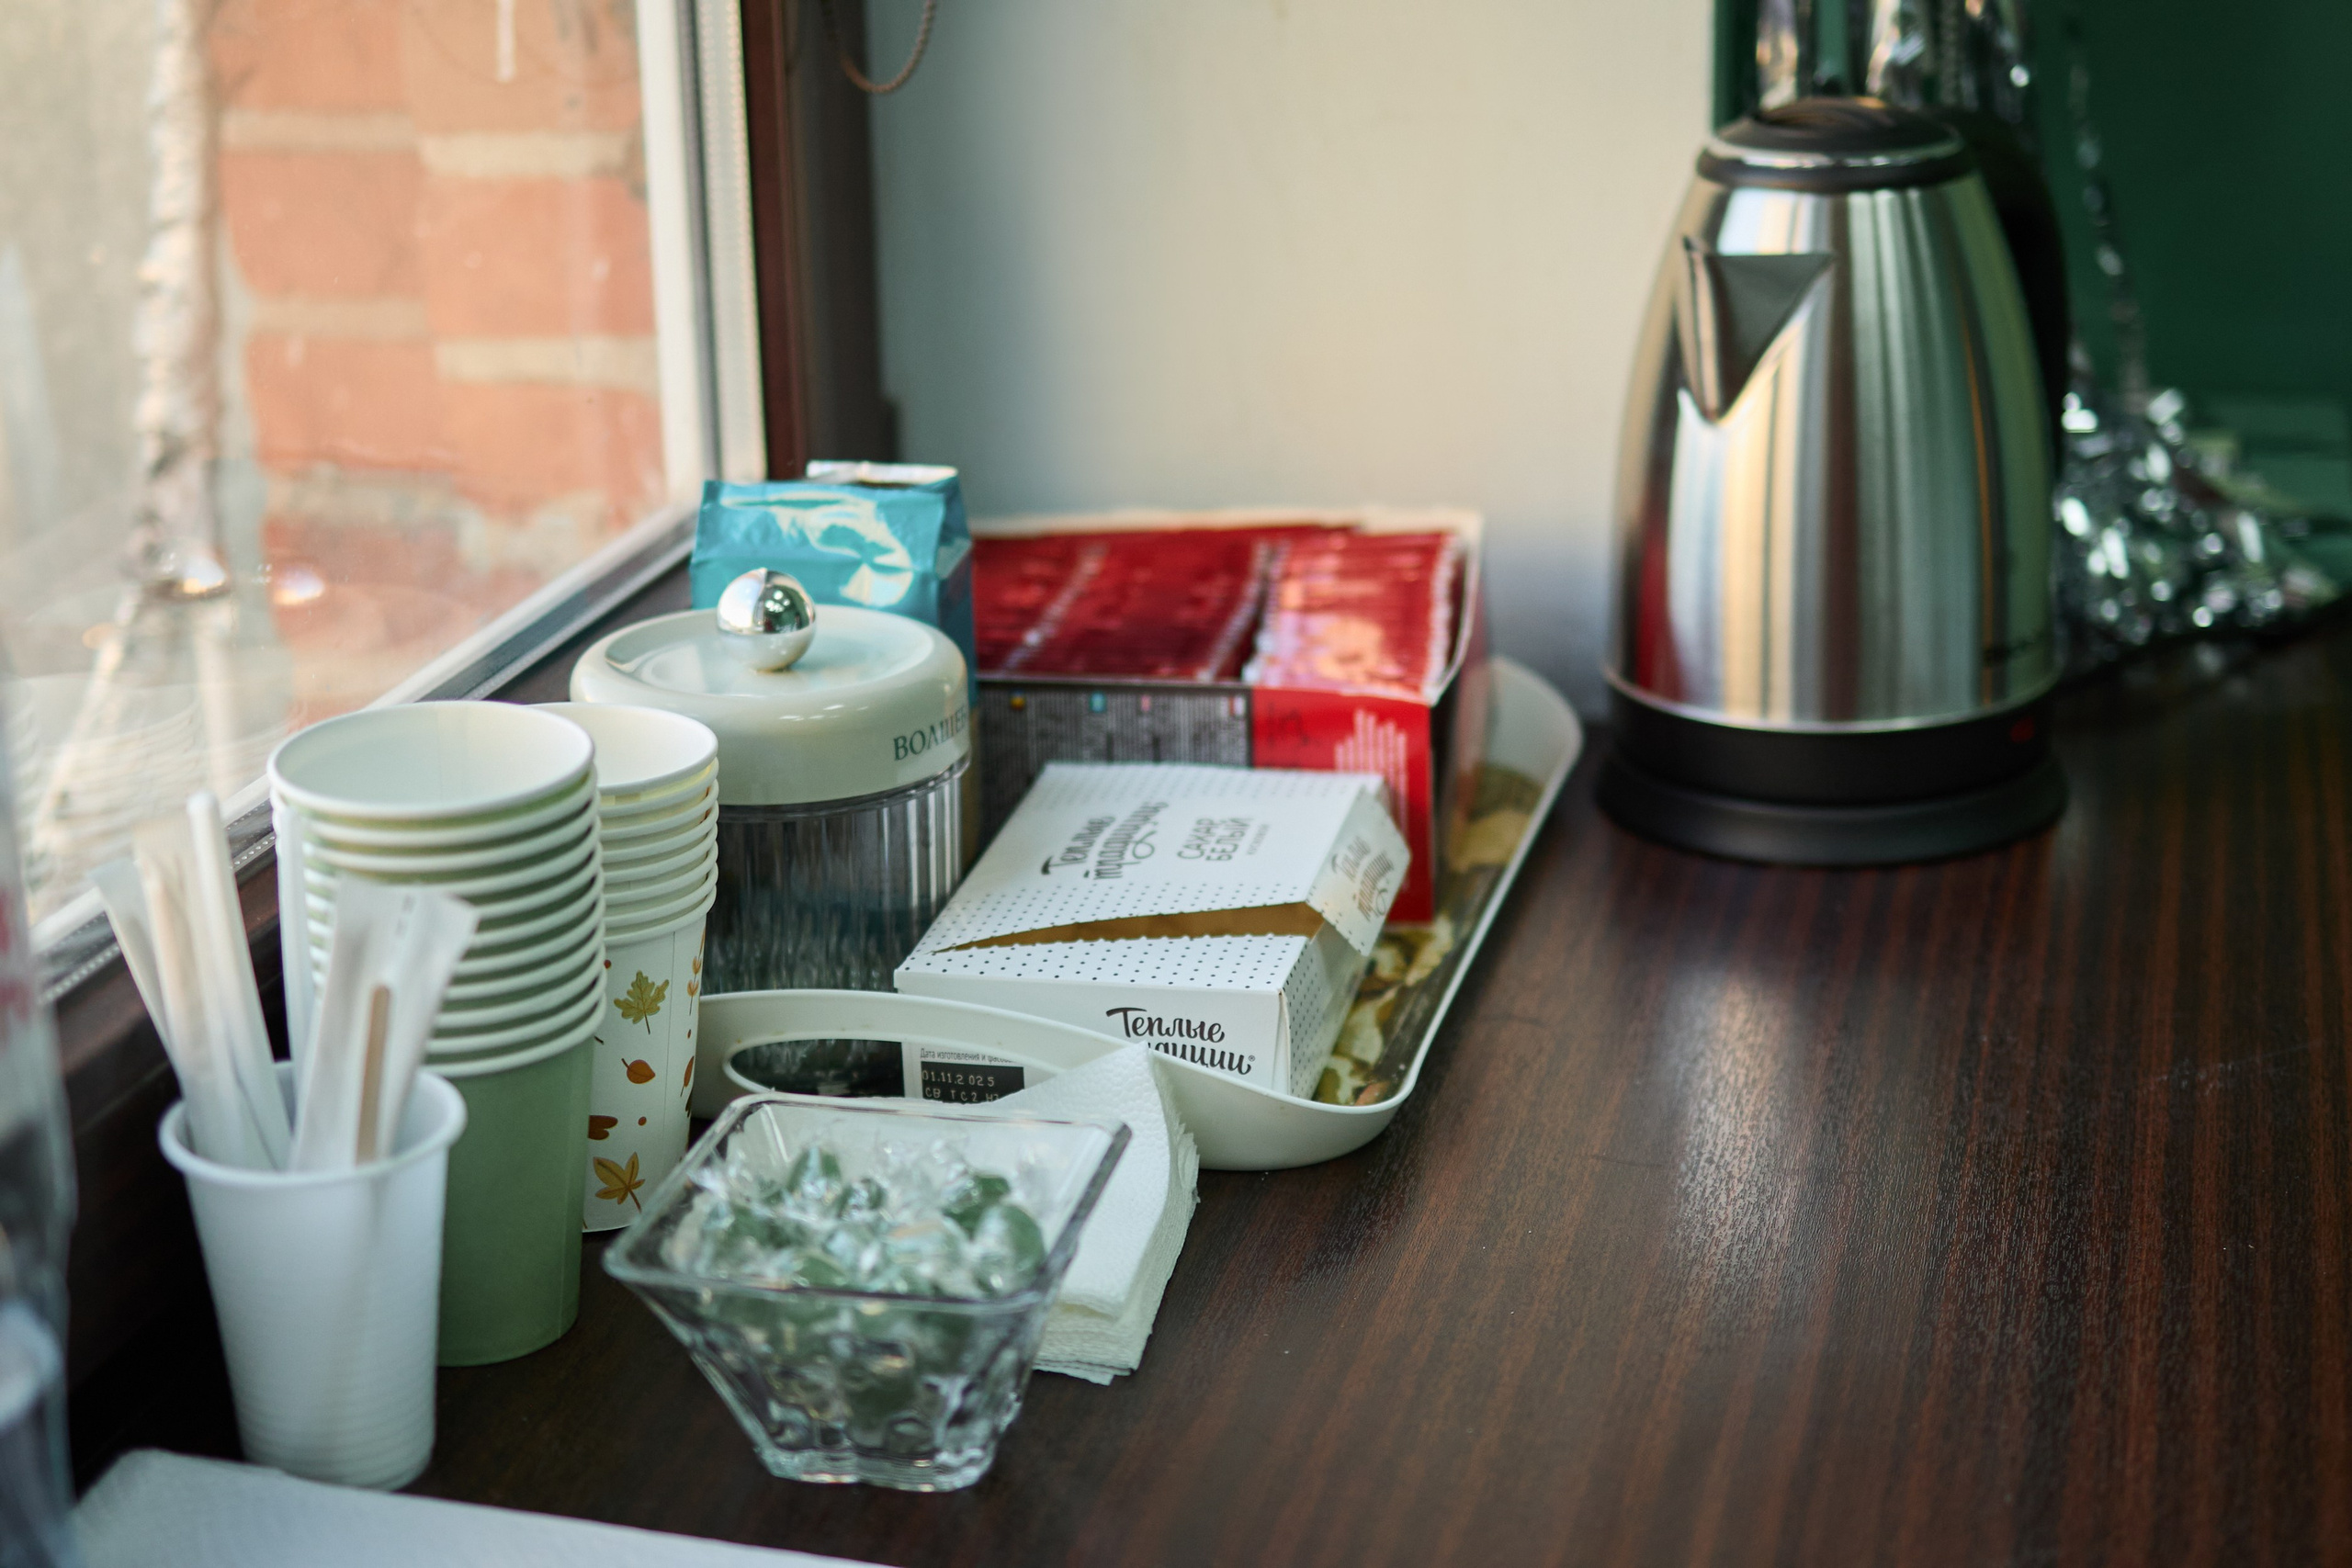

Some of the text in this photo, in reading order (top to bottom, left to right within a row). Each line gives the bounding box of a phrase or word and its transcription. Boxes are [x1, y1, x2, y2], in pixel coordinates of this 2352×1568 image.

[1176, 818, 1220, 860] САХАР
[1105, 1007, 1226, 1043] Теплые
[920, 1048, 935, 1058] Дата
[937, 1051, 979, 1061] изготовления
